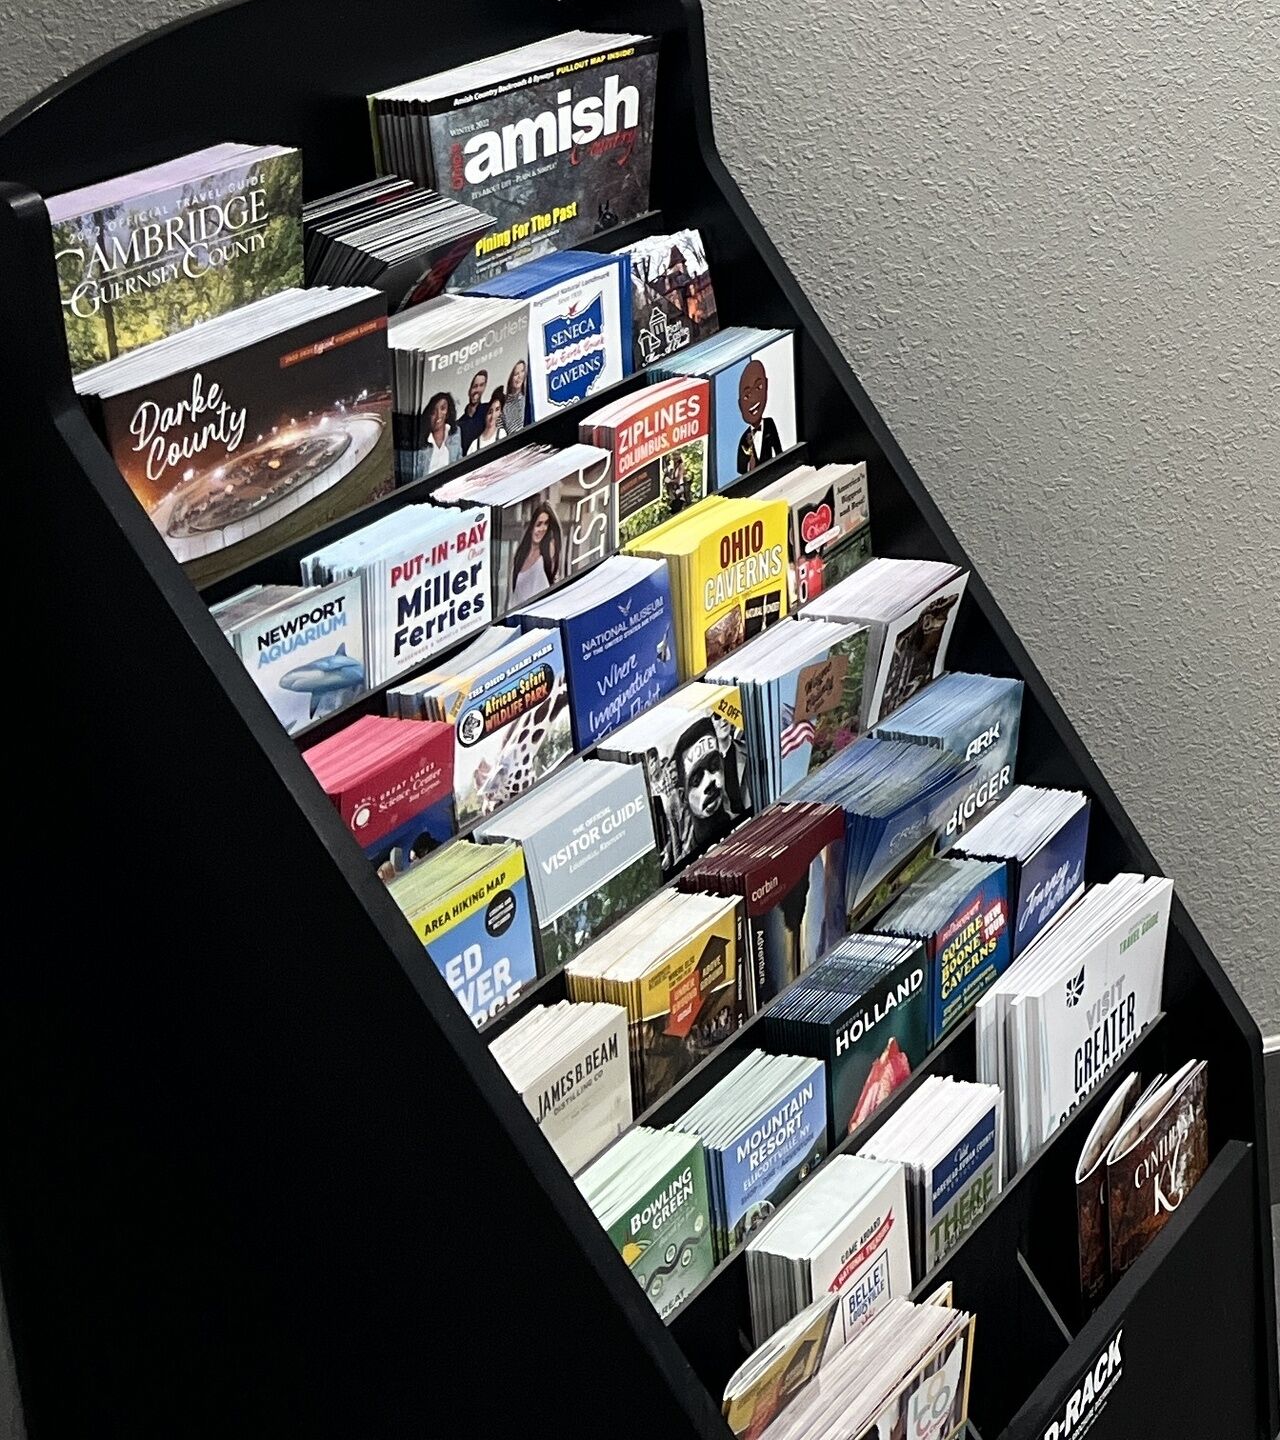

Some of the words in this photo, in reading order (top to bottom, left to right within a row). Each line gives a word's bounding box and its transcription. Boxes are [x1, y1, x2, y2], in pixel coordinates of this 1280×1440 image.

[556, 60, 589, 76] PULLOUT
[590, 56, 606, 69] MAP
[464, 74, 640, 184] amish
[109, 205, 168, 231] OFFICIAL
[175, 189, 222, 209] TRAVEL
[228, 173, 266, 194] GUIDE
[475, 229, 511, 257] Pining
[511, 222, 530, 242] For
[530, 212, 551, 234] The
[552, 201, 578, 225] Past
[66, 263, 179, 318] GUERNSEY
[183, 233, 268, 279] COUNTY
[428, 315, 529, 373] TangerOutlets
[550, 317, 596, 347] SENECA
[551, 355, 601, 391] CAVERNS
[130, 372, 224, 452] Darke
[618, 394, 701, 454] ZIPLINES
[146, 401, 247, 481] County
[619, 431, 670, 474] COLUMBUS,
[672, 420, 699, 444] OHIO
[391, 520, 488, 588] PUT-IN-BAY
[720, 520, 763, 569] OHIO
[397, 561, 482, 627] Miller
[704, 544, 782, 612] CAVERNS
[257, 596, 345, 651] NEWPORT
[258, 612, 347, 669] AQUARIUM
[394, 593, 485, 657] Ferries
[581, 621, 627, 653] NATIONAL
[629, 596, 664, 626] MUSEUM
[533, 644, 553, 661] PARK
[597, 654, 638, 696] Where
[485, 688, 517, 716] African
[519, 670, 545, 694] Safari
[485, 698, 523, 732] WILDLIFE
[525, 682, 548, 708] PARK
[589, 663, 656, 733] Imagination
[718, 699, 728, 713] $2
[727, 705, 740, 720] OFF
[687, 737, 714, 763] VOTE
[965, 721, 1000, 761] ARK
[379, 789, 411, 813] Science
[413, 768, 441, 790] Center
[380, 780, 406, 801] GREAT
[410, 762, 434, 782] LAKES
[946, 765, 1011, 836] BIGGER
[542, 827, 600, 875] VISITOR
[602, 794, 645, 834] GUIDE
[424, 911, 451, 936] AREA
[452, 888, 485, 918] HIKING
[486, 872, 506, 896] MAP
[751, 876, 778, 902] corbin
[443, 944, 483, 990] ED
[942, 913, 983, 967] SQUIRE
[942, 934, 981, 985] BOONE
[1120, 931, 1140, 955] TRAVEL
[457, 957, 512, 1014] VER
[941, 938, 997, 1000] CAVERNS
[835, 969, 923, 1057] HOLLAND
[1086, 974, 1126, 1031] VISIT
[1074, 991, 1136, 1094] GREATER
[536, 1070, 574, 1125] JAMES
[575, 1063, 585, 1084] B.
[585, 1032, 618, 1076] BEAM
[554, 1078, 592, 1115] DISTILLING
[736, 1082, 814, 1165] MOUNTAIN
[749, 1110, 803, 1171] RESORT
[800, 1123, 812, 1138] NY
[630, 1166, 693, 1236] BOWLING
[652, 1181, 694, 1231] GREEN
[930, 1162, 994, 1252] THERE
[841, 1240, 858, 1265] COME
[859, 1216, 881, 1246] ABOARD
[661, 1288, 686, 1315] REAT
[848, 1265, 880, 1315] BELLE
